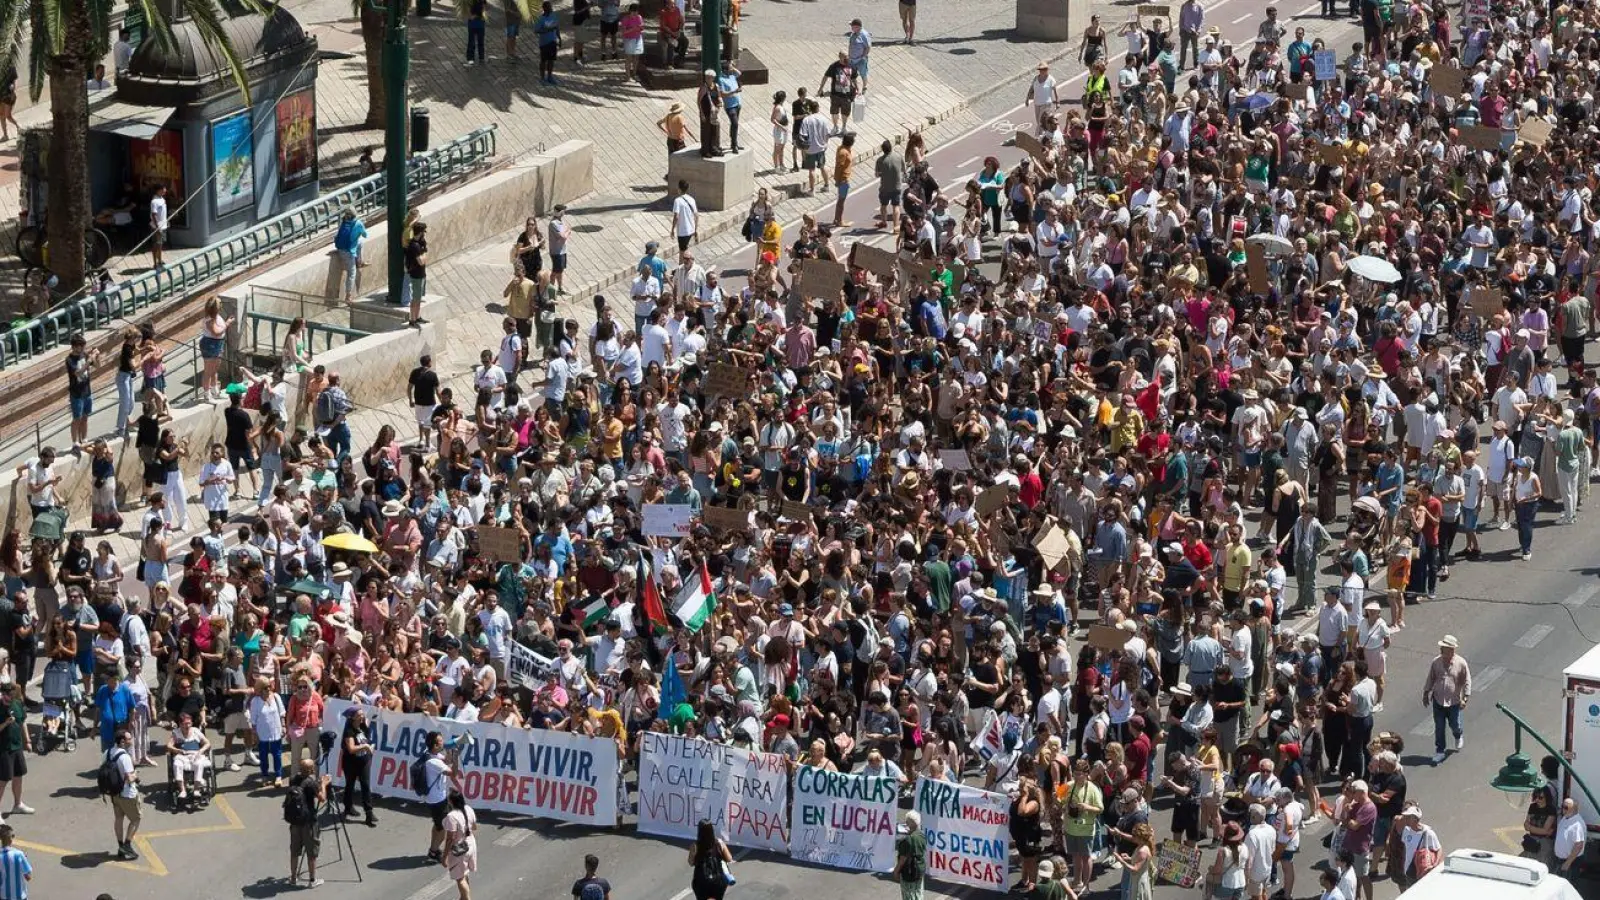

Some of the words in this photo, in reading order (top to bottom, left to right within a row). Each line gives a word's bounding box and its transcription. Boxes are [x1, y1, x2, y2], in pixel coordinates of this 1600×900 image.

[454, 736, 517, 771] ARA
[528, 743, 598, 786] VIVIR,
[643, 732, 734, 766] ENTERATE
[746, 751, 787, 774] AVRA
[650, 764, 664, 783] A
[666, 765, 721, 792] CALLE
[732, 775, 774, 802] JARA
[798, 765, 897, 804] CORRALAS
[919, 779, 961, 819] AVRA
[640, 789, 706, 827] NADIE
[728, 802, 787, 842] PARA
[803, 804, 826, 826] EN
[831, 803, 894, 836] LUCHA
[950, 833, 1004, 861] DEJAN
[929, 851, 946, 871] IN
[949, 856, 1004, 885] CASAS
